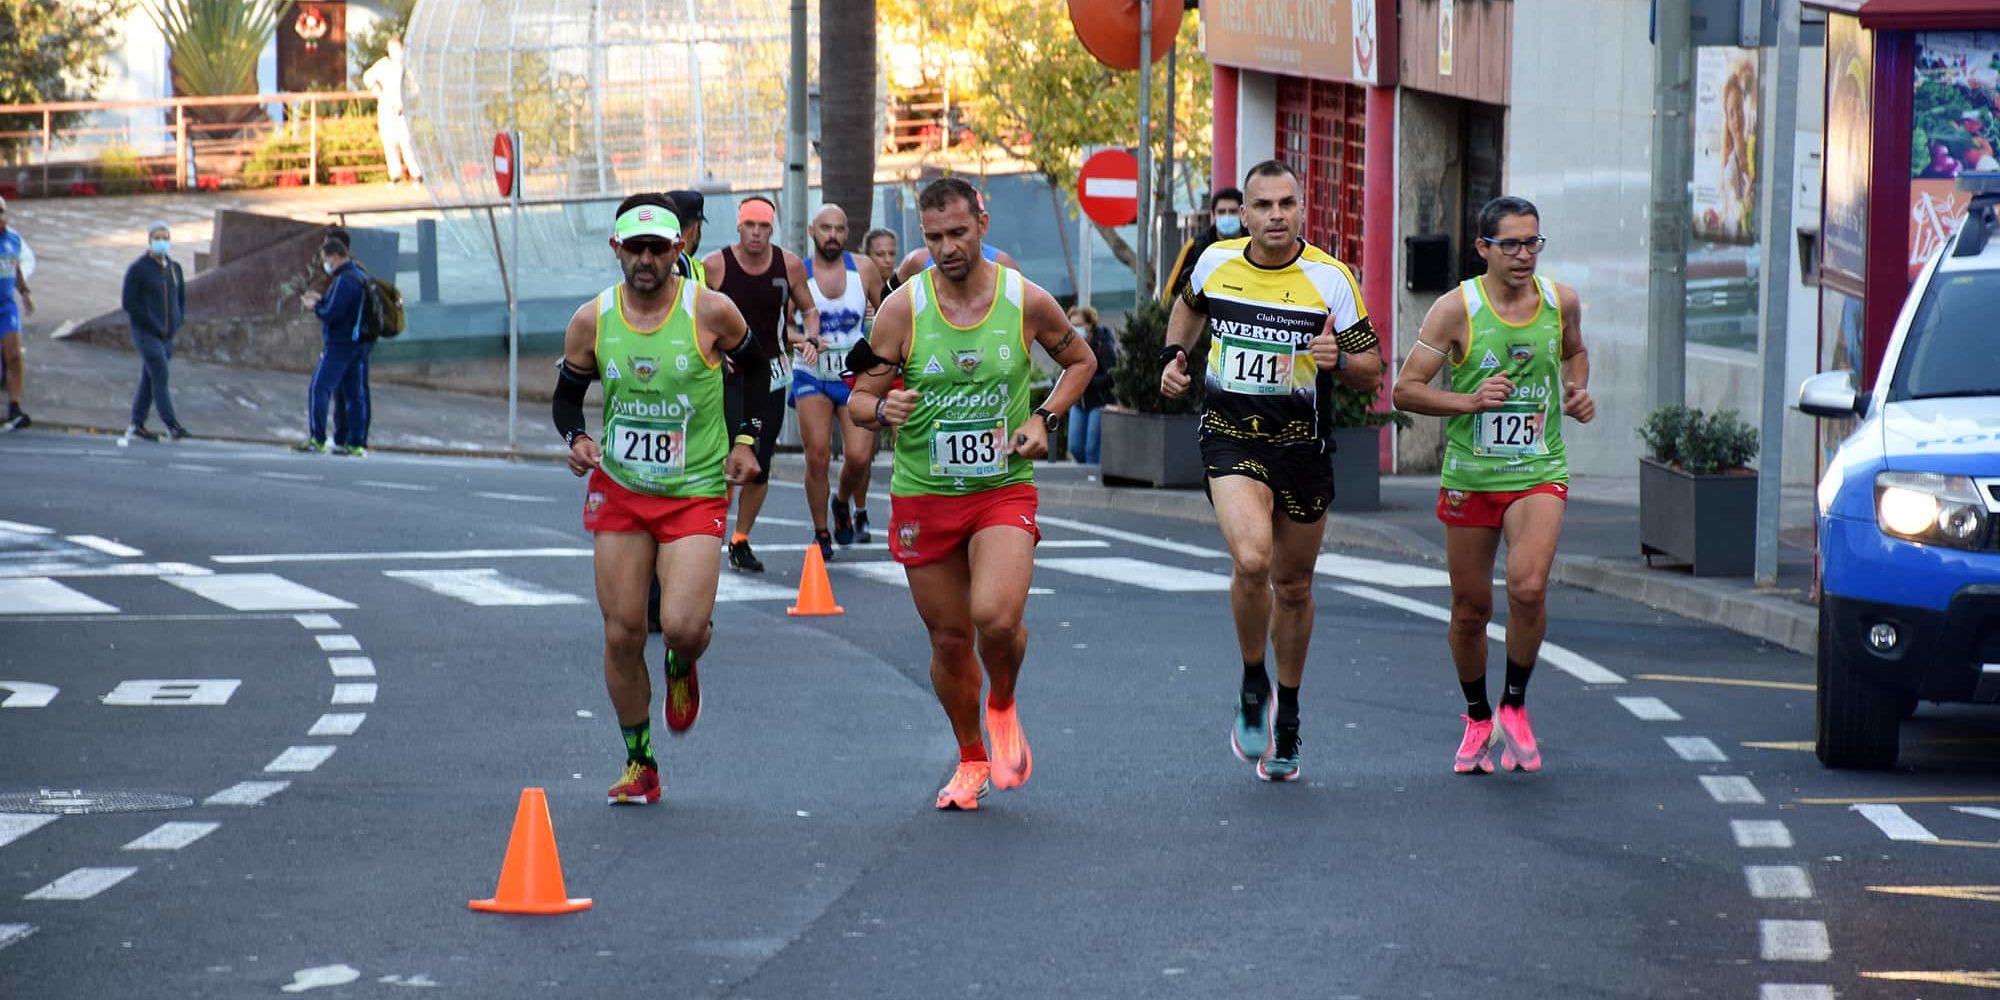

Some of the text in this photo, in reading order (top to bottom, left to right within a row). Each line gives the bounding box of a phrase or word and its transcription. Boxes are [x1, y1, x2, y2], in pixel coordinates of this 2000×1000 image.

[1255, 0, 1294, 39] HONG
[1297, 0, 1337, 45] KONG
[1256, 312, 1315, 327] Club Deportivo
[826, 354, 843, 371] 14
[1234, 350, 1279, 385] 141
[613, 395, 681, 417] Curbelo
[923, 388, 1000, 408] Curbelo
[1492, 415, 1535, 446] 125
[624, 430, 672, 464] 218
[946, 431, 996, 465] 183
